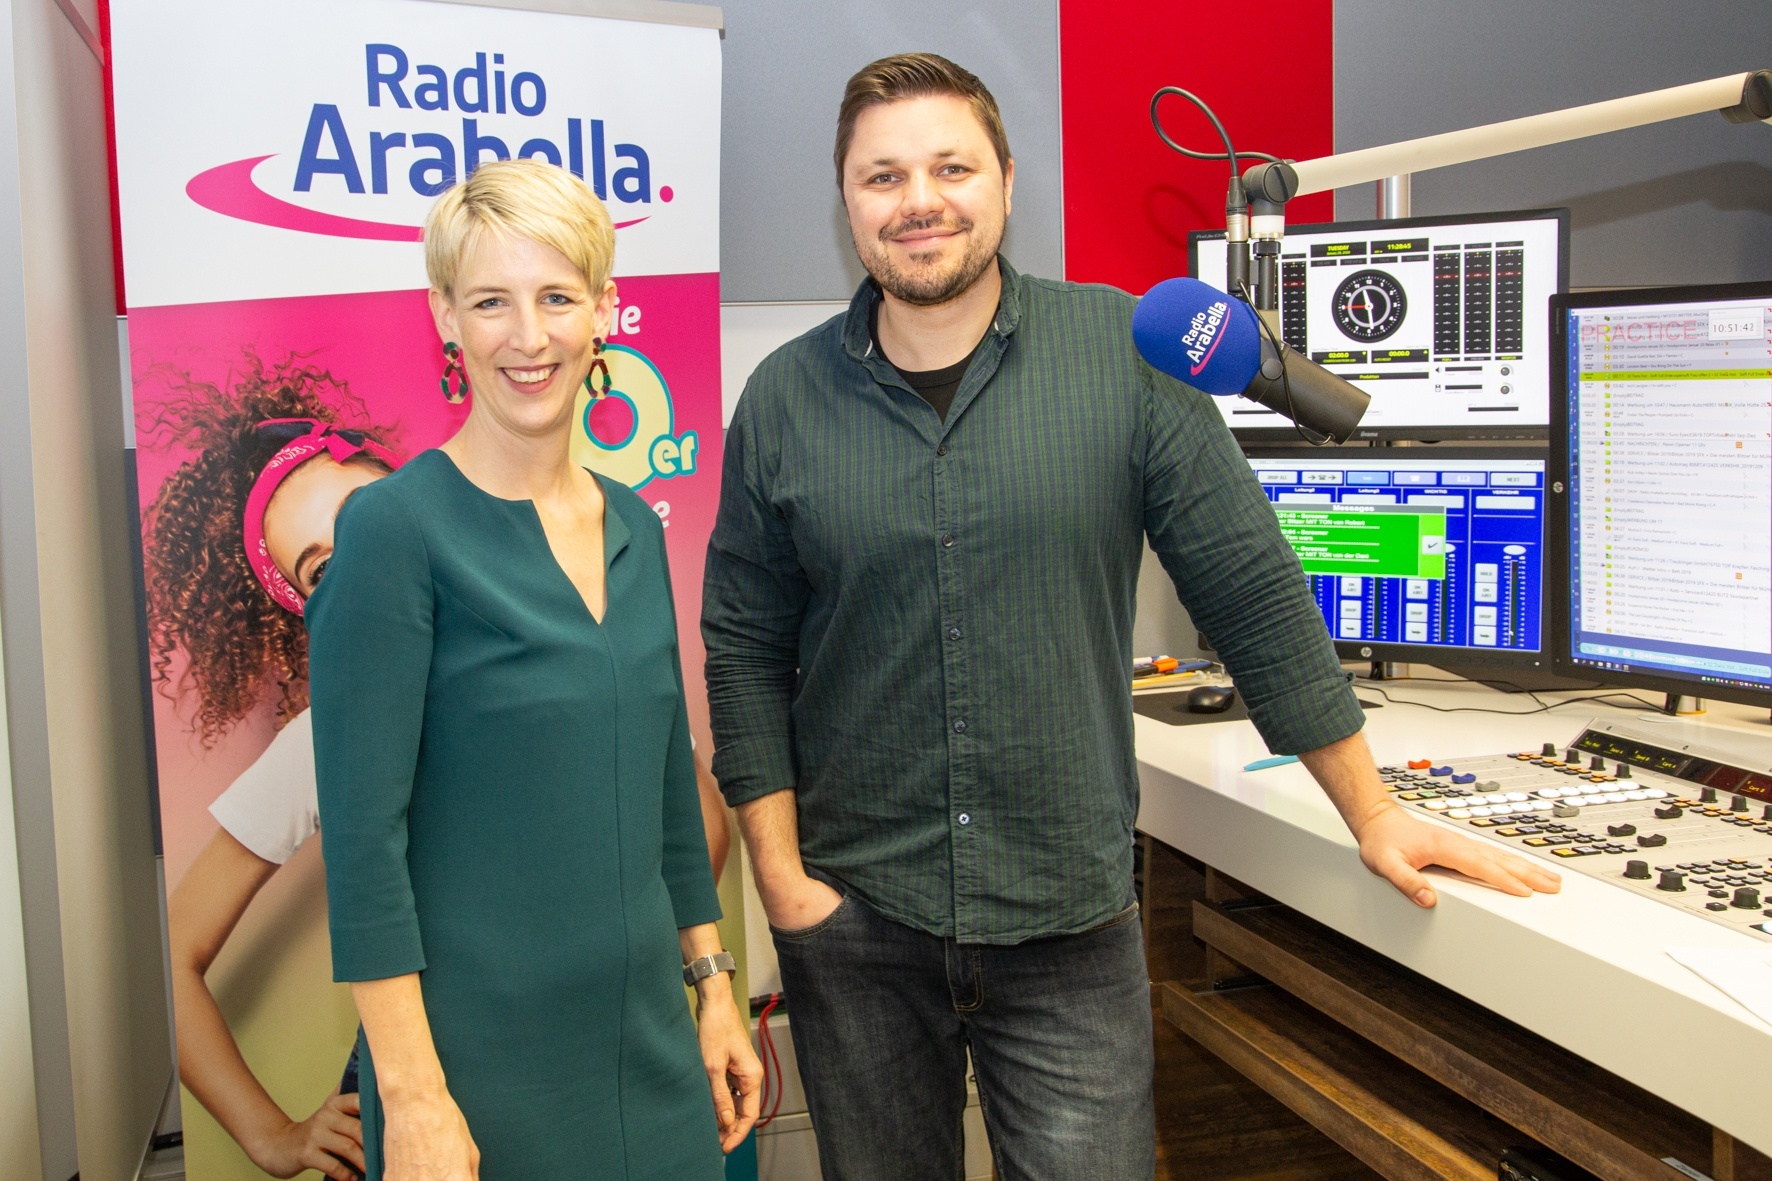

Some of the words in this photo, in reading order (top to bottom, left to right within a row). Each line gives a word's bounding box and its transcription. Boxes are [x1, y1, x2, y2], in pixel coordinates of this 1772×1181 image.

[365, 43, 546, 116] Radio
[1182, 312, 1206, 346] Radio
[1582, 321, 1696, 343] PRACTICE
[1713, 323, 1754, 333] 10:51:42
